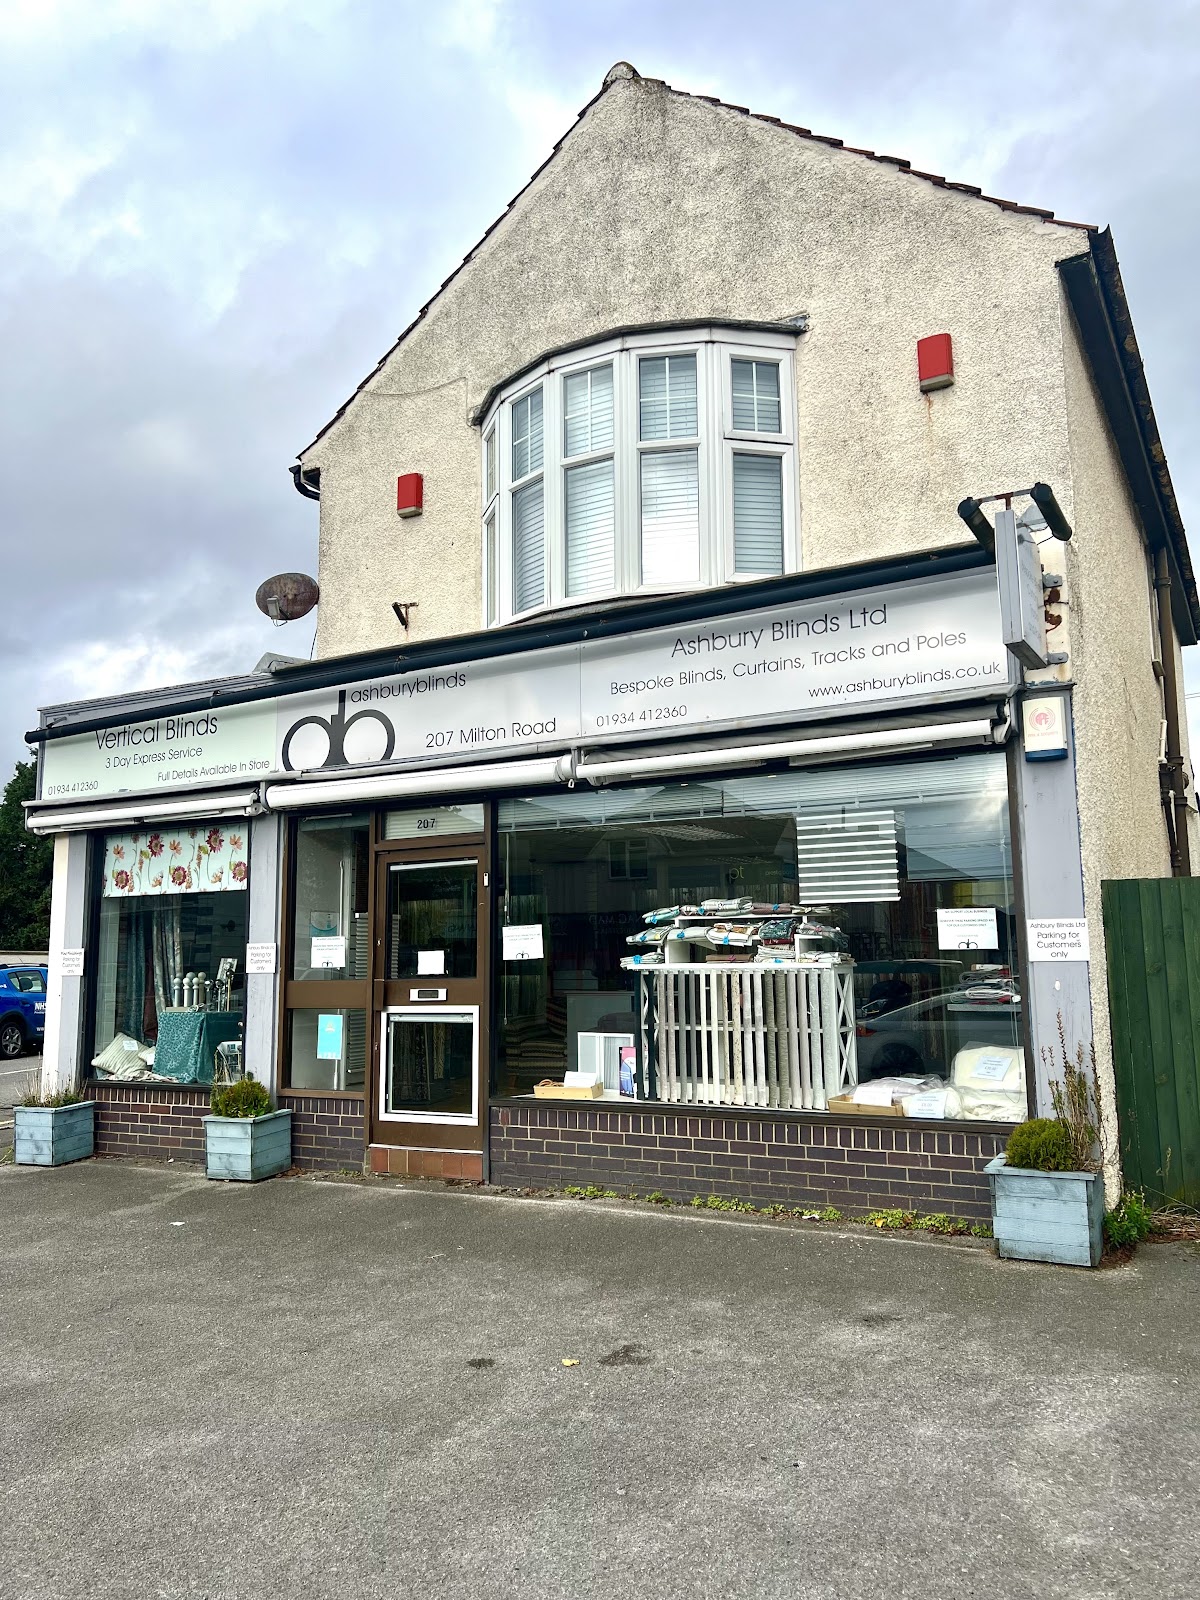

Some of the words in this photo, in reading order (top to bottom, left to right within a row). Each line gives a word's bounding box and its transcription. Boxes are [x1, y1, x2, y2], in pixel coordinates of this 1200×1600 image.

[671, 628, 764, 658] Ashbury
[771, 614, 840, 642] Blinds
[849, 603, 887, 629] Ltd
[610, 675, 674, 695] Bespoke
[679, 667, 726, 686] Blinds,
[732, 655, 806, 678] Curtains,
[812, 645, 866, 667] Tracks
[872, 638, 910, 657] and
[917, 630, 967, 651] Poles
[350, 671, 467, 703] ashburyblinds
[808, 661, 1001, 698] www.ashburyblinds.co.uk
[596, 711, 635, 728] 01934
[639, 705, 688, 721] 412360
[94, 720, 160, 750] Vertical
[165, 713, 218, 741] Blinds
[425, 730, 454, 749] 207
[459, 724, 506, 744] Milton
[511, 717, 557, 738] Road
[105, 757, 111, 769] 3
[113, 755, 131, 769] Day
[133, 750, 166, 766] Express
[168, 746, 203, 760] Service
[157, 770, 170, 782] Full
[171, 767, 199, 781] Details
[199, 762, 238, 777] Available
[239, 761, 247, 772] In
[248, 759, 270, 771] Store
[48, 782, 70, 796] 01934
[71, 780, 99, 793] 412360
[417, 818, 436, 830] 207
[1036, 940, 1082, 948] Customers
[1037, 931, 1067, 940] Parking
[1068, 931, 1080, 939] for
[1050, 950, 1069, 959] only
